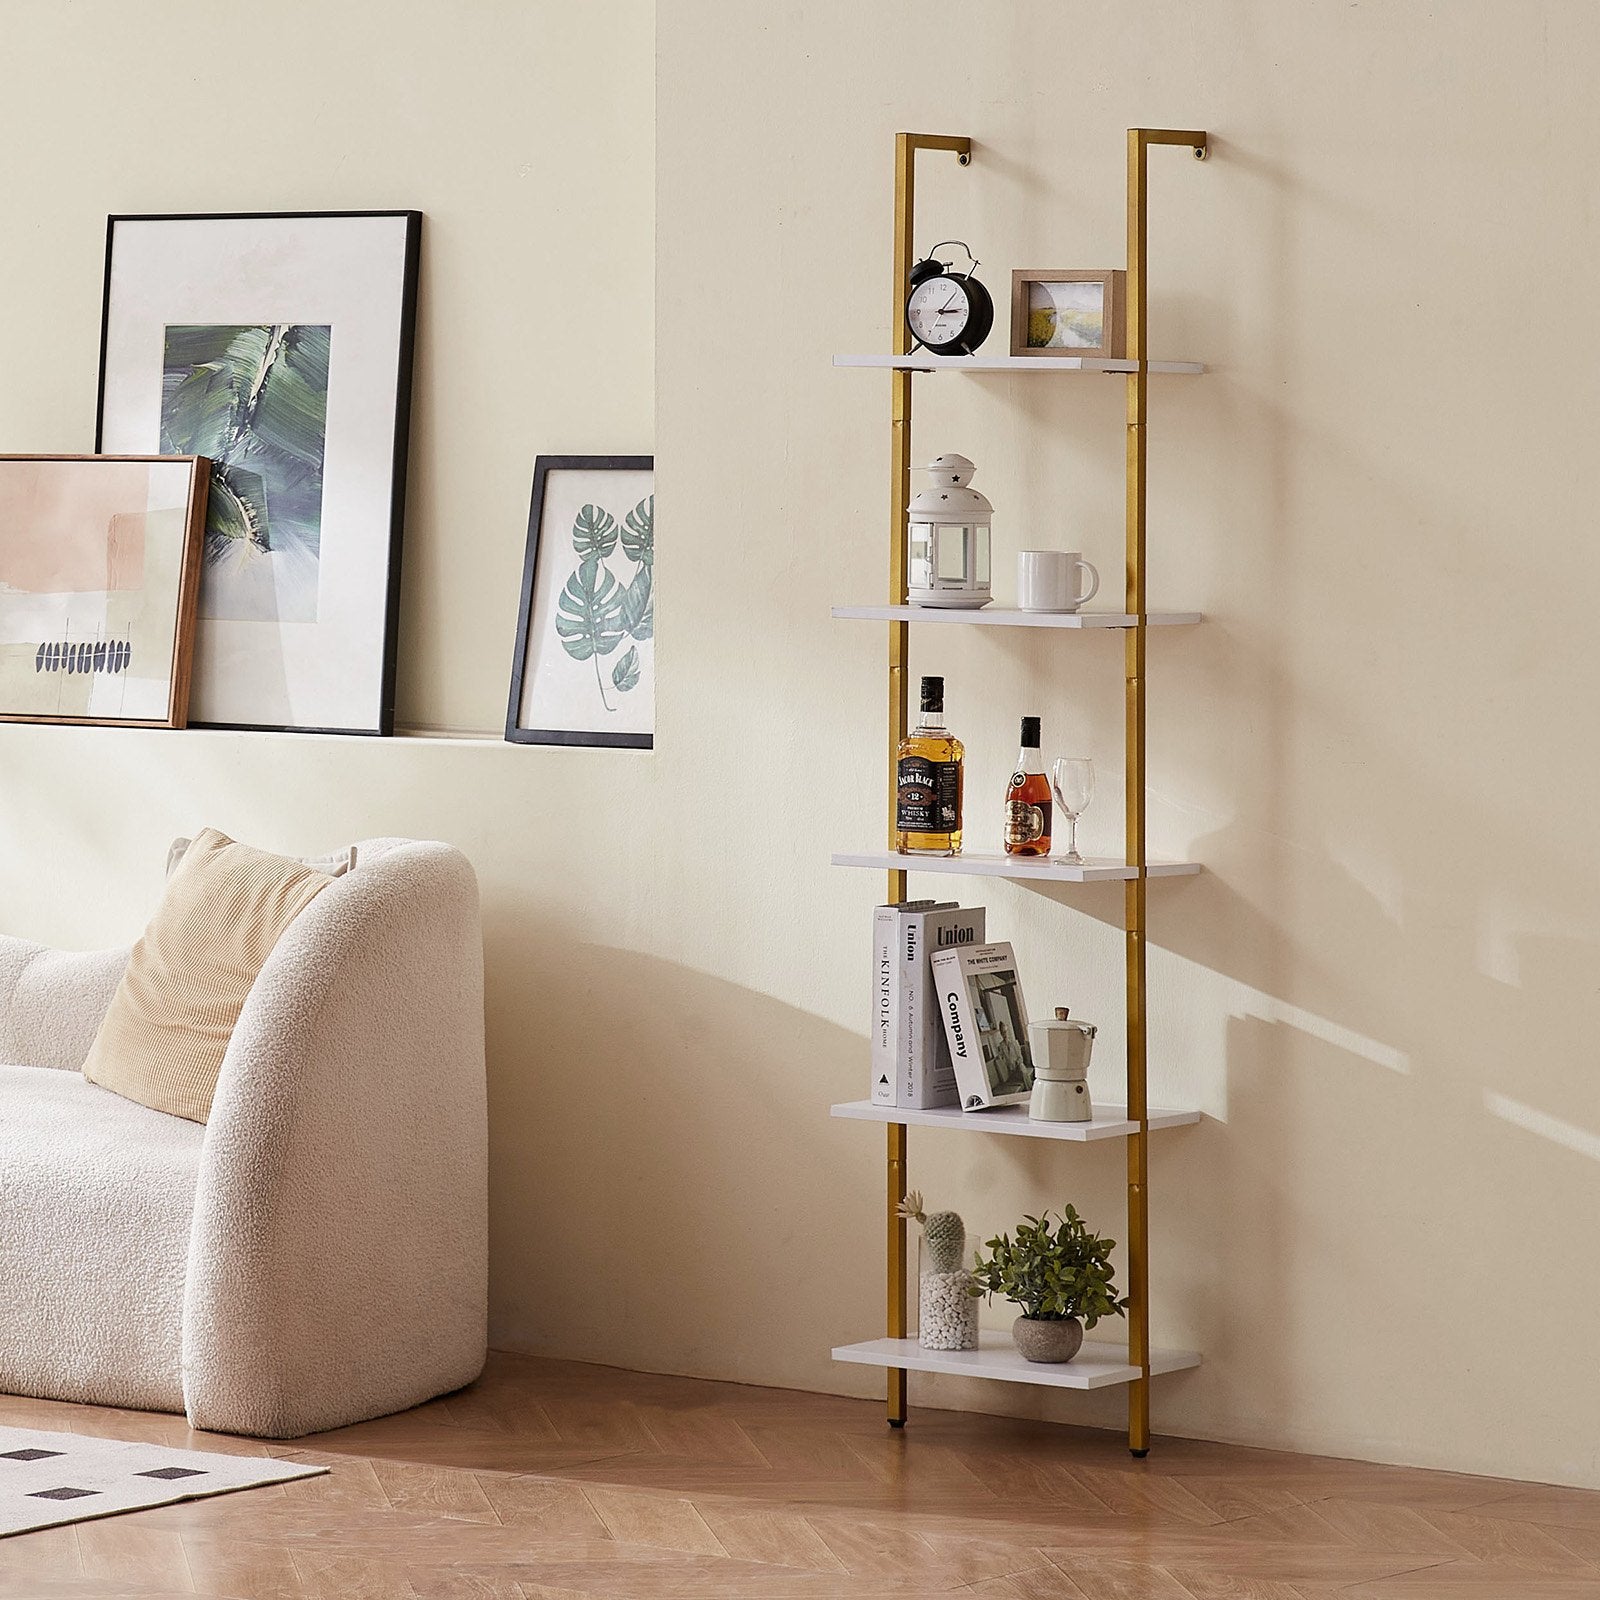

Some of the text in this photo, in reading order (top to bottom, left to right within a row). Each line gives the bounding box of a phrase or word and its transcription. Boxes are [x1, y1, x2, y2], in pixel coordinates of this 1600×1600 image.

[940, 284, 947, 292] 12
[911, 793, 920, 801] 12
[901, 809, 930, 817] WHISKY
[907, 924, 917, 961] Union
[937, 924, 974, 946] Union
[988, 955, 1008, 963] COMPANY
[881, 960, 890, 1028] KINFOLK
[947, 992, 968, 1058] Company
